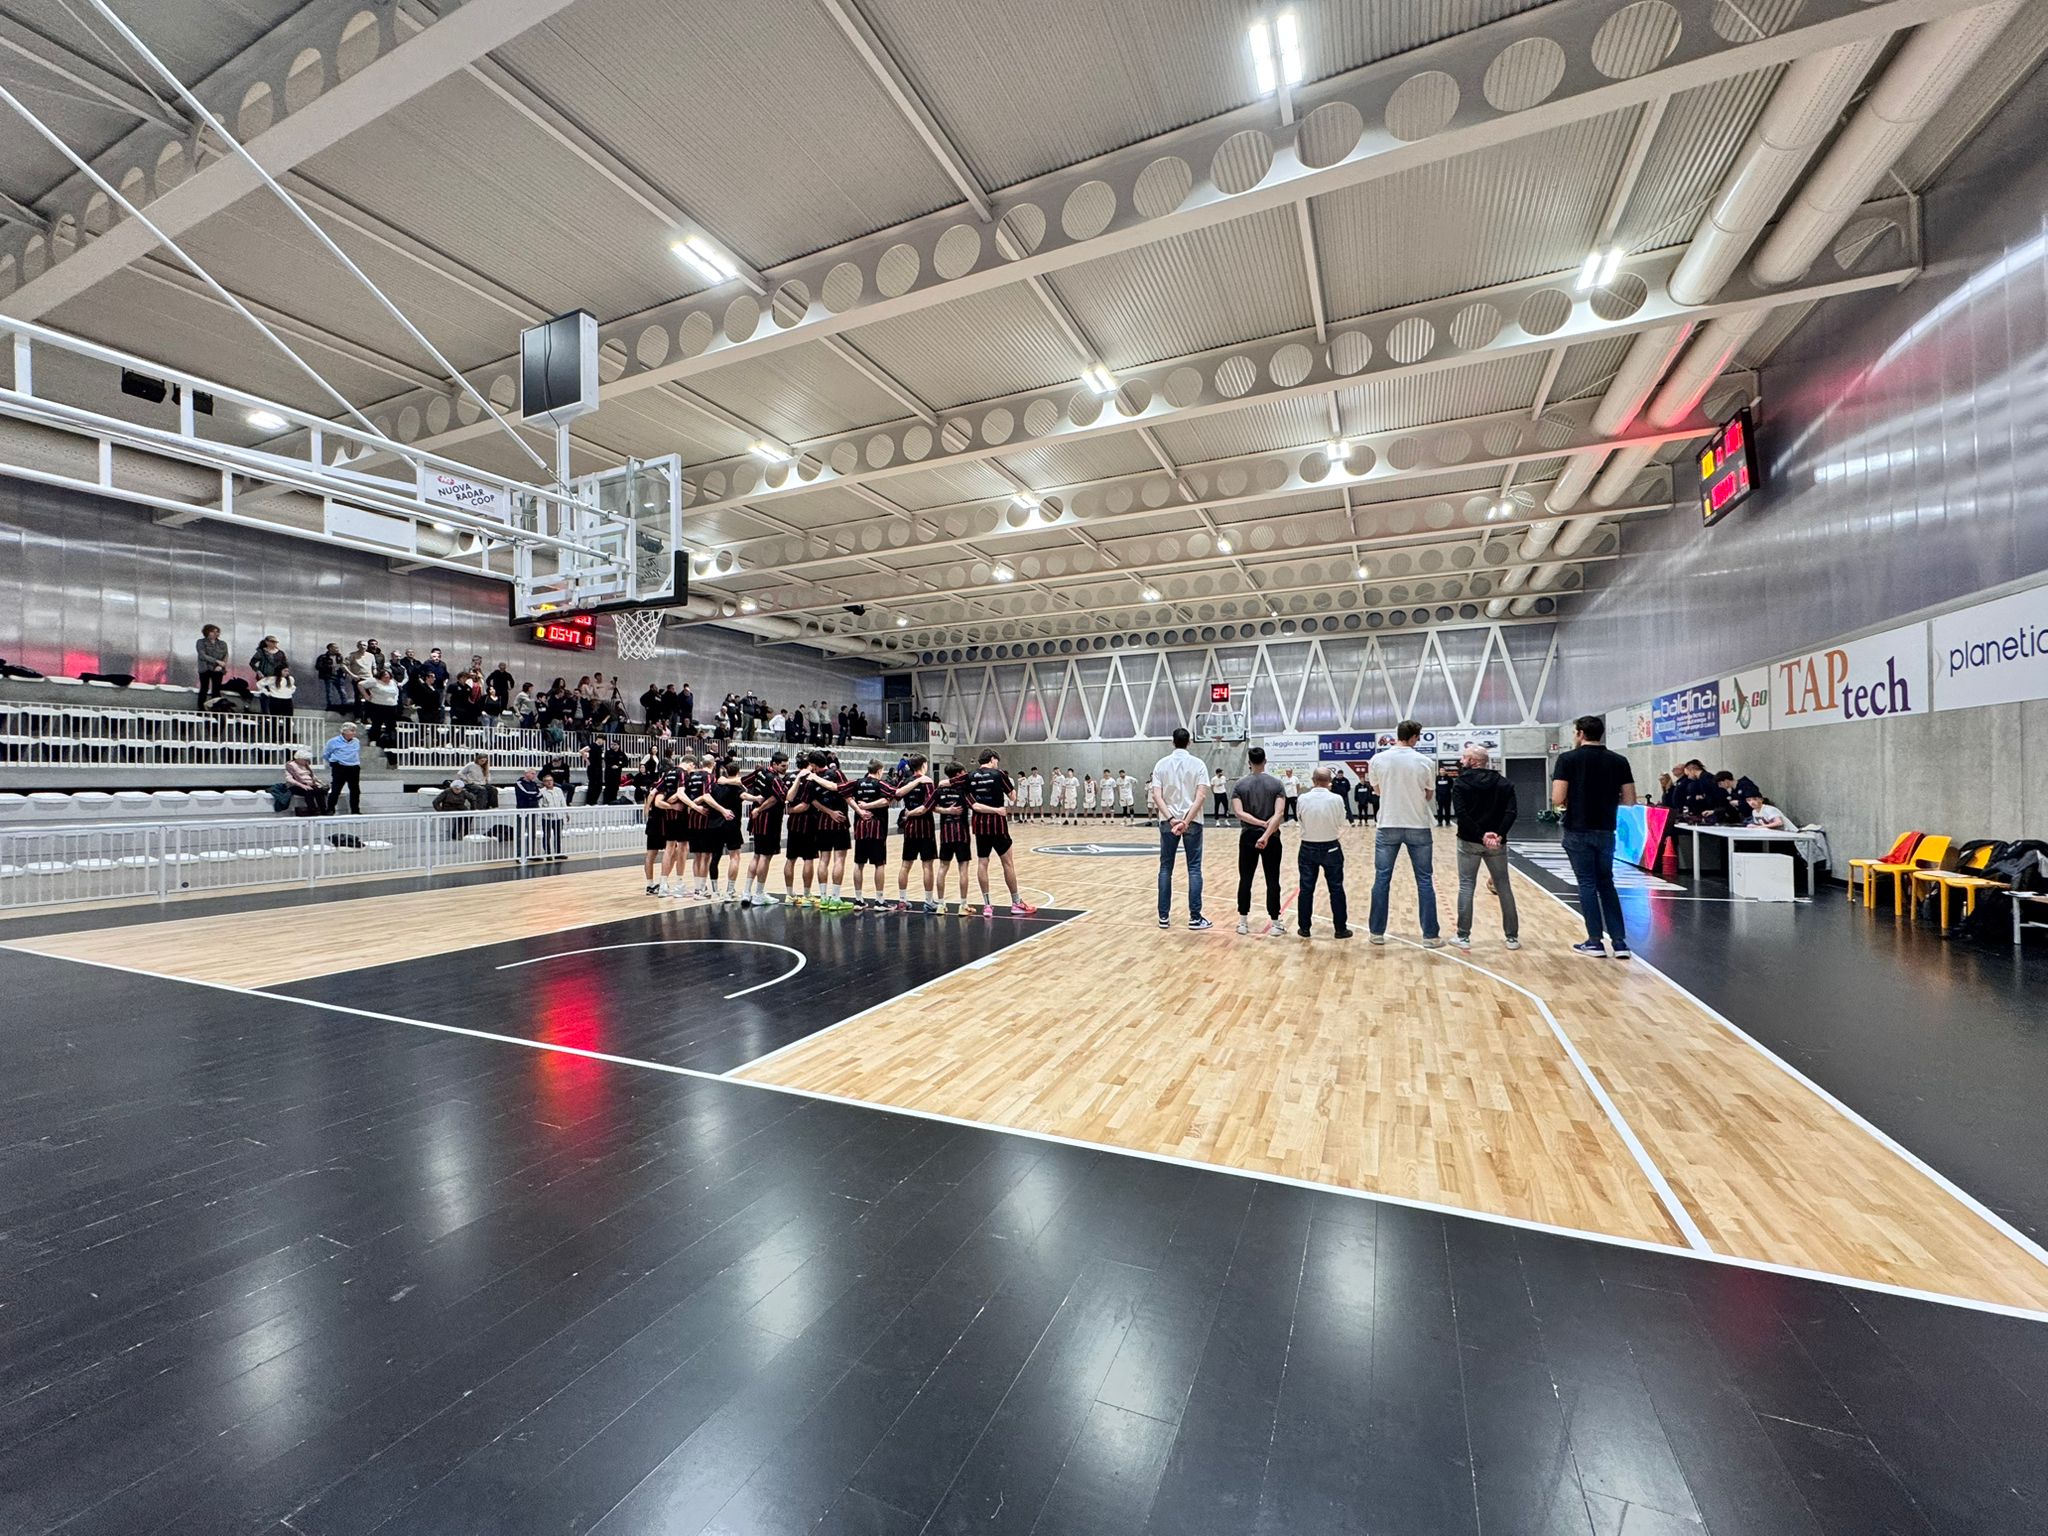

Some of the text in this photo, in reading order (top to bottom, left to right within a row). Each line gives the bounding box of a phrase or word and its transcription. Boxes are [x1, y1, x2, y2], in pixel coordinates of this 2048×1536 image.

[438, 483, 472, 496] NUOVA
[456, 489, 485, 501] RADAR
[471, 495, 495, 506] COOP
[1779, 649, 1911, 719] TAP tech
[1212, 687, 1228, 699] 24
[1354, 741, 1376, 750] GRU
